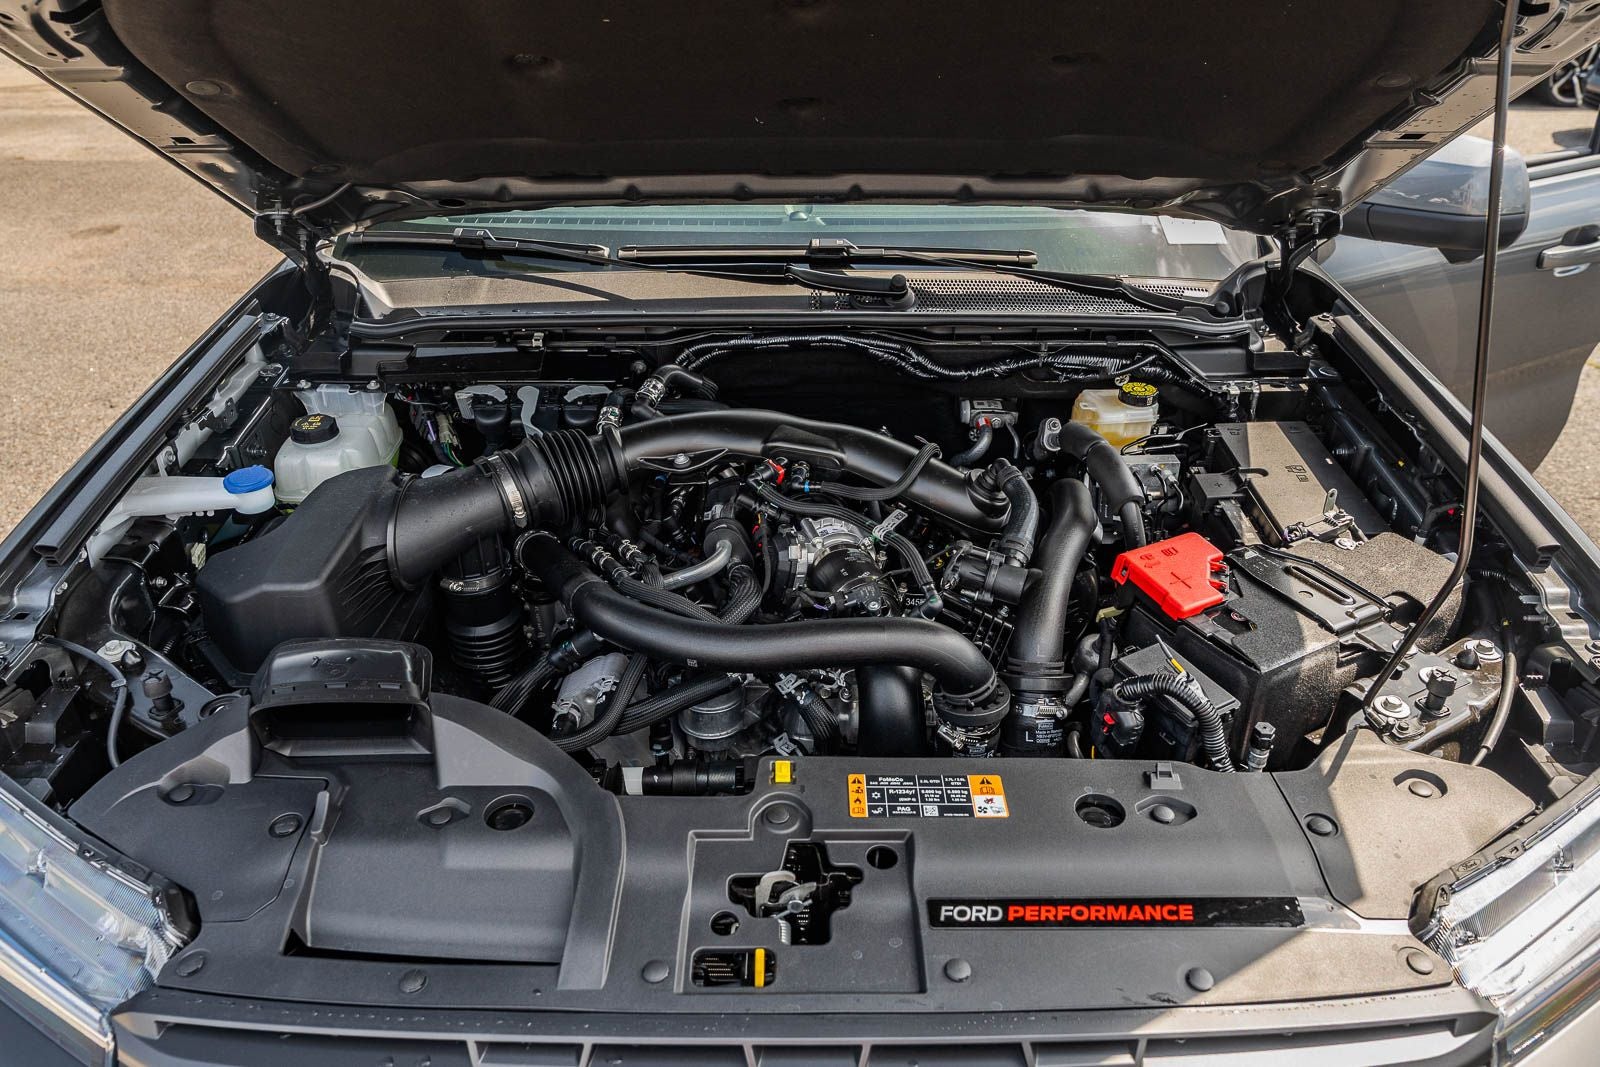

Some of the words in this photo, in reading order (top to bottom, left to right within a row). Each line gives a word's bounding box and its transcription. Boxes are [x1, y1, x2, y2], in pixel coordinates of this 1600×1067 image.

[1025, 731, 1034, 742] L
[939, 905, 1003, 921] FORD
[1007, 904, 1194, 921] PERFORMANCE
